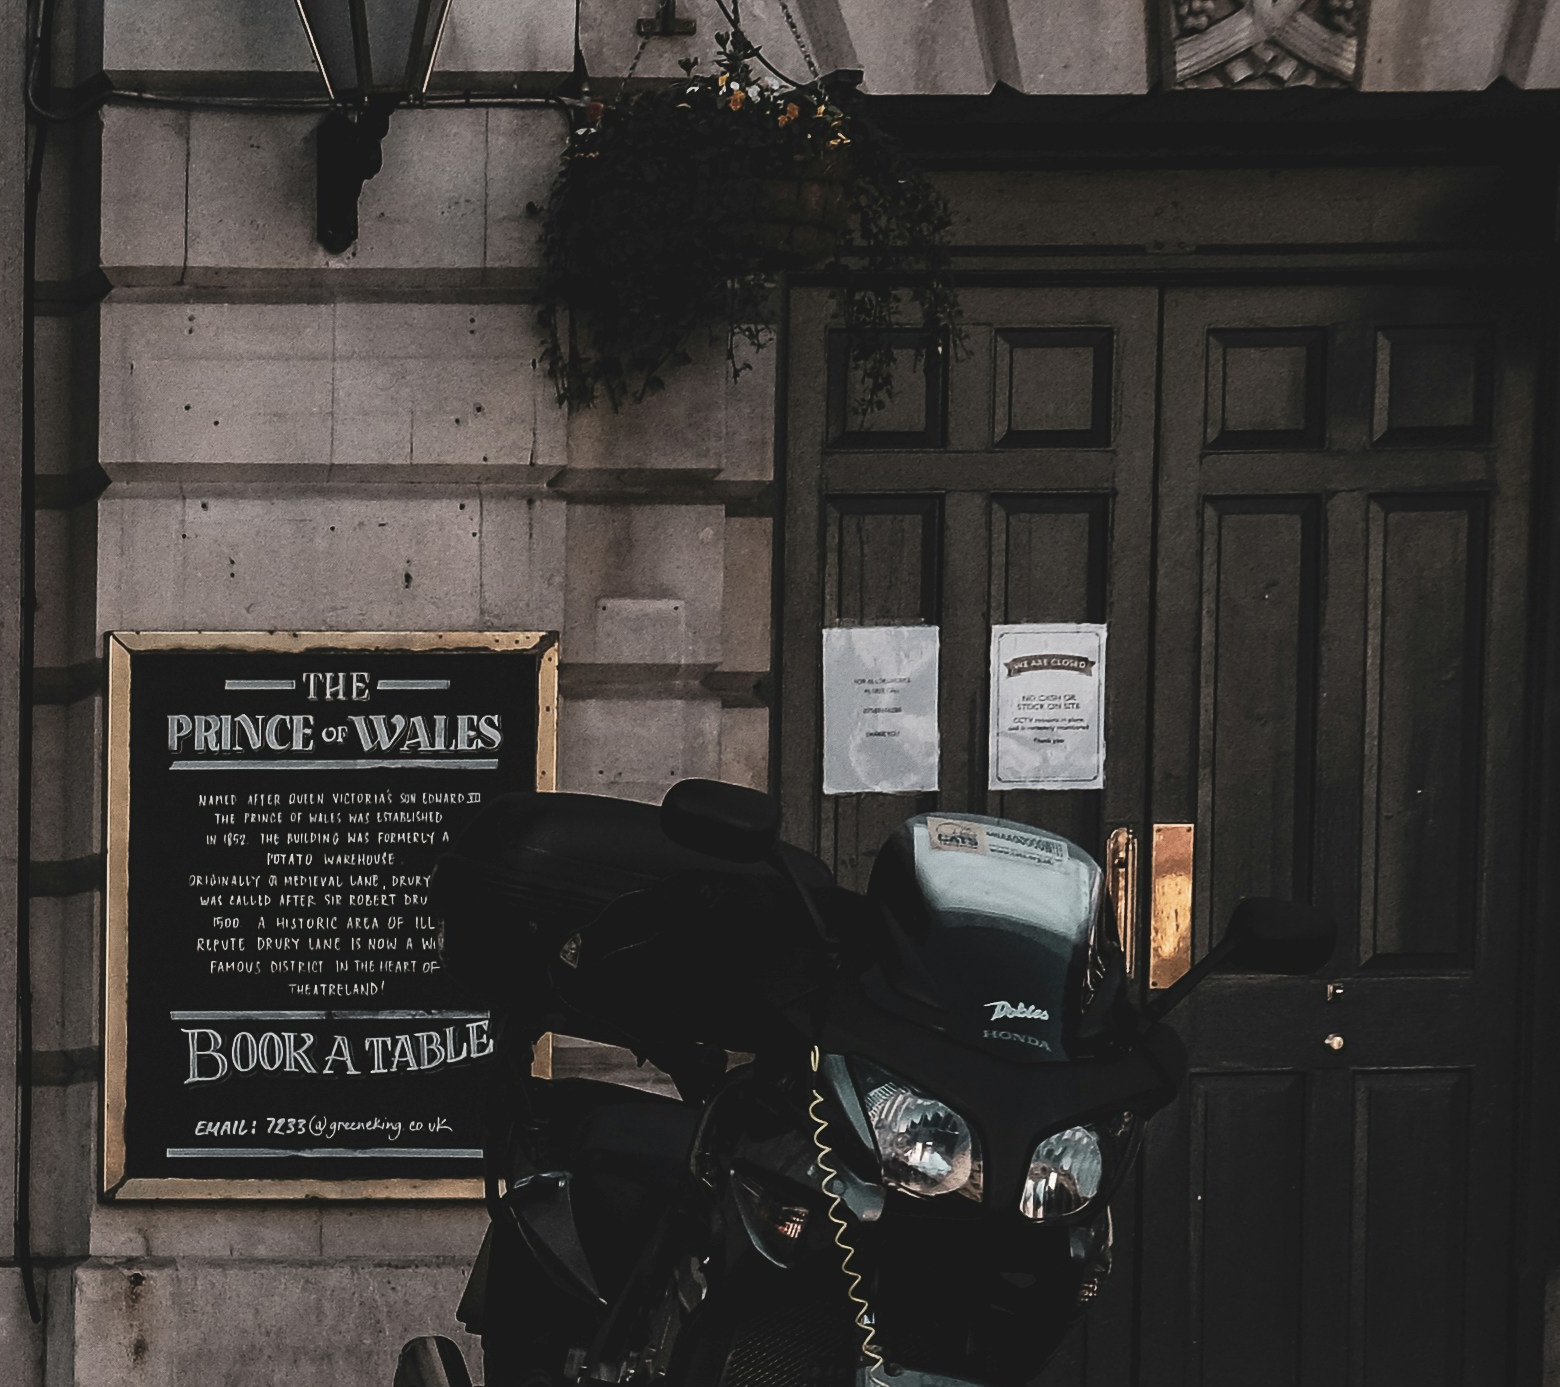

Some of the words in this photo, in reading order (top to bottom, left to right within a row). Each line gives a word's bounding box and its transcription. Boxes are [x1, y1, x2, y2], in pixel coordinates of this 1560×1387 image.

[303, 672, 370, 700] THE
[167, 714, 315, 753] PRINCE
[348, 714, 503, 753] WALES
[199, 794, 237, 806] NAMED
[247, 793, 281, 806] AFTER
[289, 792, 324, 805] QUEEN
[332, 789, 393, 805] VICTORIA'S
[400, 793, 416, 804] SON
[422, 792, 465, 805] EDWARD
[215, 813, 235, 825] THE
[244, 812, 282, 824] PRINCE
[290, 812, 302, 824] OF
[309, 812, 342, 824] WALES
[349, 812, 370, 824] WAS
[376, 811, 443, 824] ESTABLISHED
[206, 835, 217, 845] IN
[261, 833, 280, 844] THE
[287, 832, 340, 845] BUILDING
[347, 832, 370, 844] WAS
[378, 832, 435, 845] FORMERLY
[442, 831, 450, 843] A
[267, 853, 313, 866] POTATO
[189, 874, 260, 888] ORIGINALLY
[284, 875, 343, 888] MEDIEVAL
[392, 875, 432, 888] DRURY
[200, 894, 222, 906] WAS
[229, 894, 271, 907] CALLED
[280, 894, 316, 908] AFTER
[324, 894, 342, 906] SIR
[349, 894, 397, 906] ROBERT
[213, 916, 240, 929] 1500
[257, 916, 266, 929] A
[276, 916, 338, 930] HISTORIC
[346, 916, 379, 930] AREA
[387, 916, 405, 930] OF
[196, 937, 246, 952] REPUTE
[257, 937, 300, 951] DRURY
[308, 937, 341, 951] LANE
[351, 937, 361, 951] IS
[368, 937, 398, 950] NOW
[406, 937, 413, 950] A
[210, 960, 261, 974] FAMOUS
[270, 960, 324, 973] DISTRICT
[335, 960, 349, 973] IN
[354, 960, 375, 973] THE
[380, 960, 417, 973] HEART
[422, 960, 441, 974] OF
[288, 980, 385, 997] THEATRELAND!
[983, 1030, 1054, 1054] HONDA
[180, 1026, 319, 1085] BOOK
[323, 1035, 362, 1075] A
[365, 1019, 495, 1074] TABLE
[195, 1119, 258, 1136] EMAIL:
